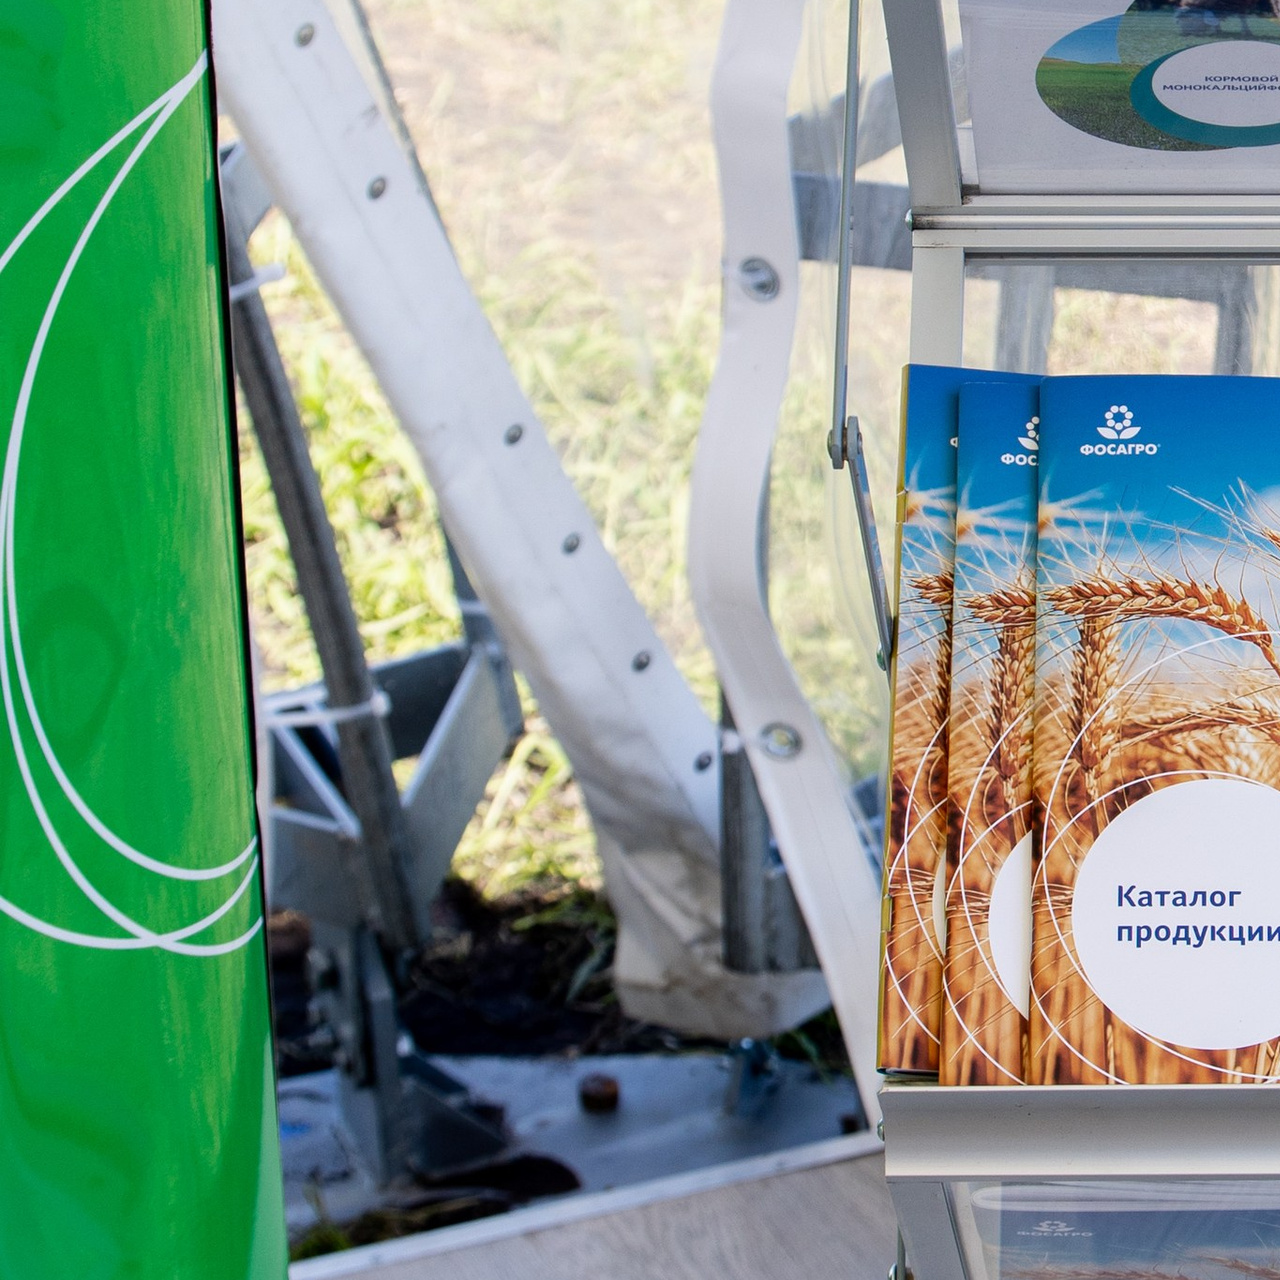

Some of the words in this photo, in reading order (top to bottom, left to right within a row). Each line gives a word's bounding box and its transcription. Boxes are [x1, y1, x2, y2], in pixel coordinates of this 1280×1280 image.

[1080, 443, 1158, 456] ФОСАГРО
[1001, 453, 1039, 466] ФОС
[1117, 885, 1242, 907] Каталог
